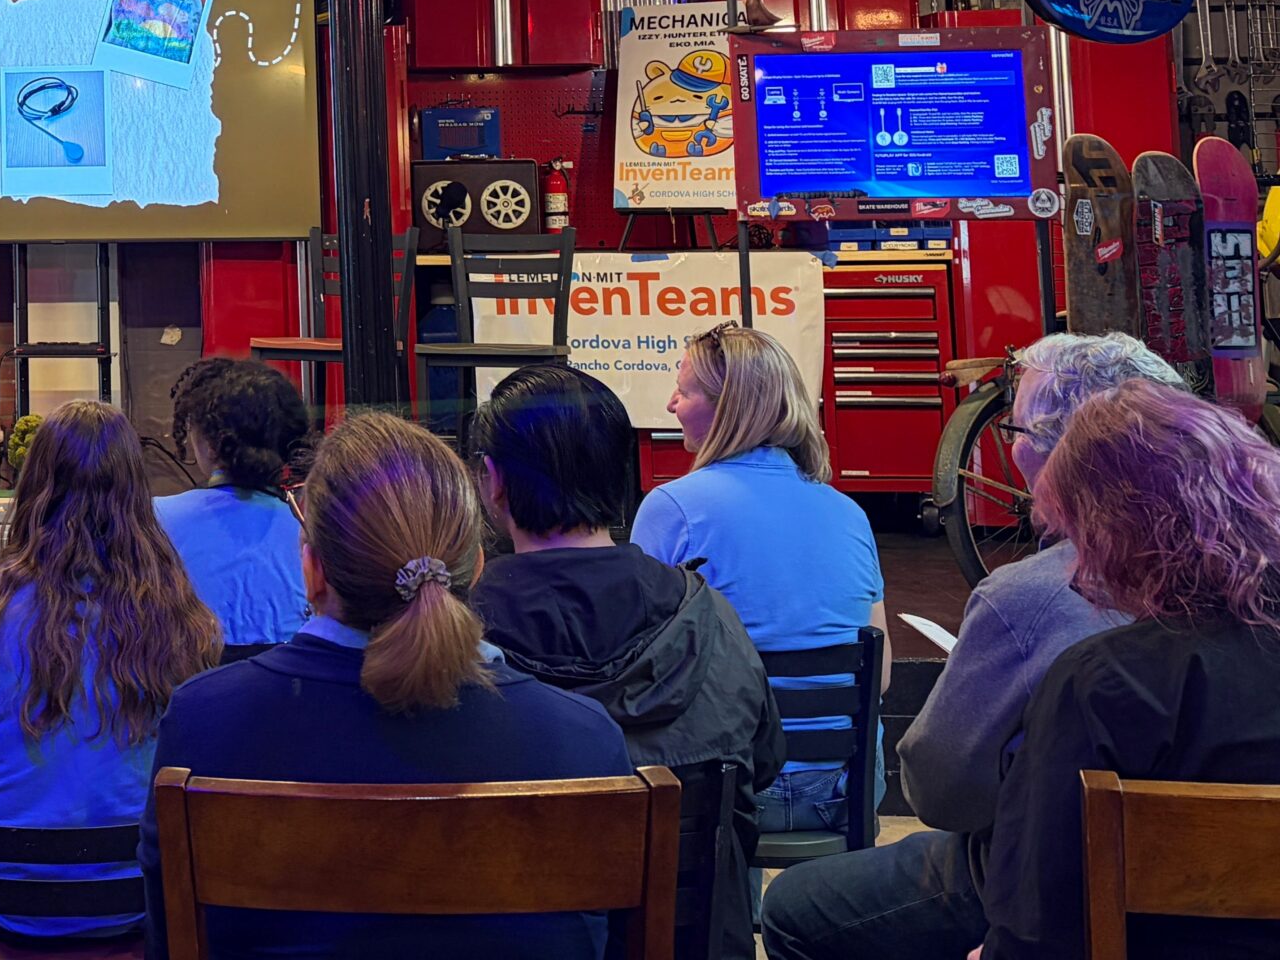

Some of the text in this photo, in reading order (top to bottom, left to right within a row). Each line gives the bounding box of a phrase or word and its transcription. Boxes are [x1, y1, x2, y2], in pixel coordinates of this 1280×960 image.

[741, 87, 750, 100] GO
[649, 190, 691, 198] CORDOVA
[887, 274, 924, 283] HUSKY
[568, 334, 631, 349] ordova
[637, 334, 677, 353] High
[614, 360, 671, 372] Cordova,
